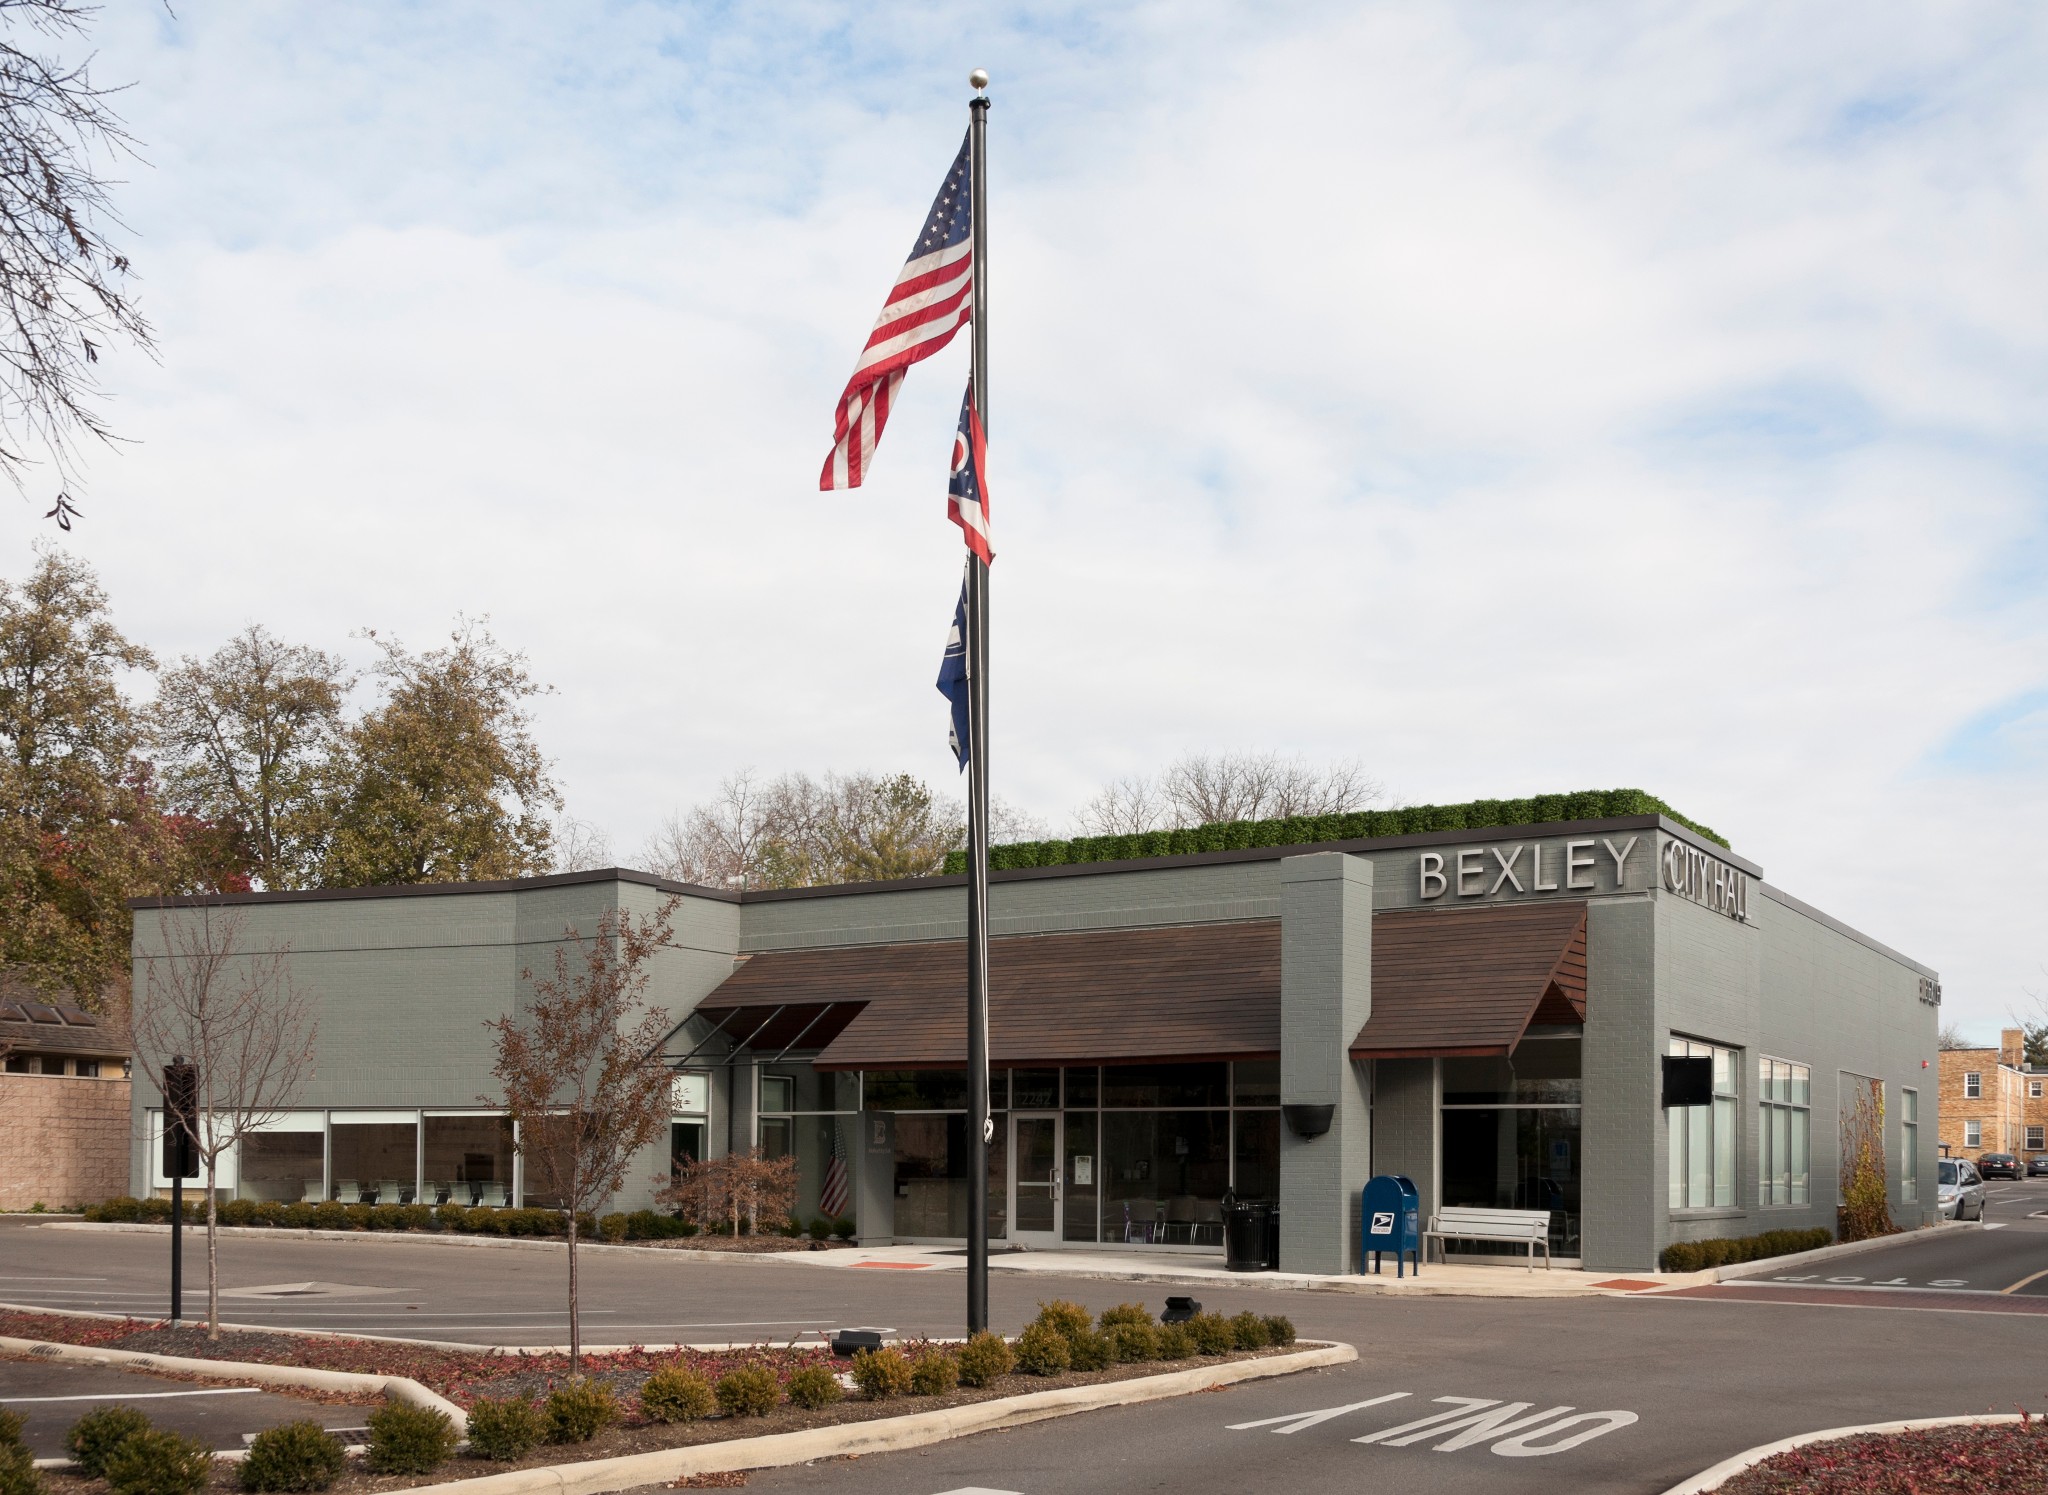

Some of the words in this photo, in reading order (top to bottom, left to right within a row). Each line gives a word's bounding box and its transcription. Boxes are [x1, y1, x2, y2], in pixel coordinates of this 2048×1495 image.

[1420, 836, 1639, 899] BEXLEY
[1664, 840, 1708, 900] CITY
[1712, 860, 1751, 920] HALL
[1772, 1274, 1969, 1287] STOP
[1224, 1392, 1639, 1457] ONLY
